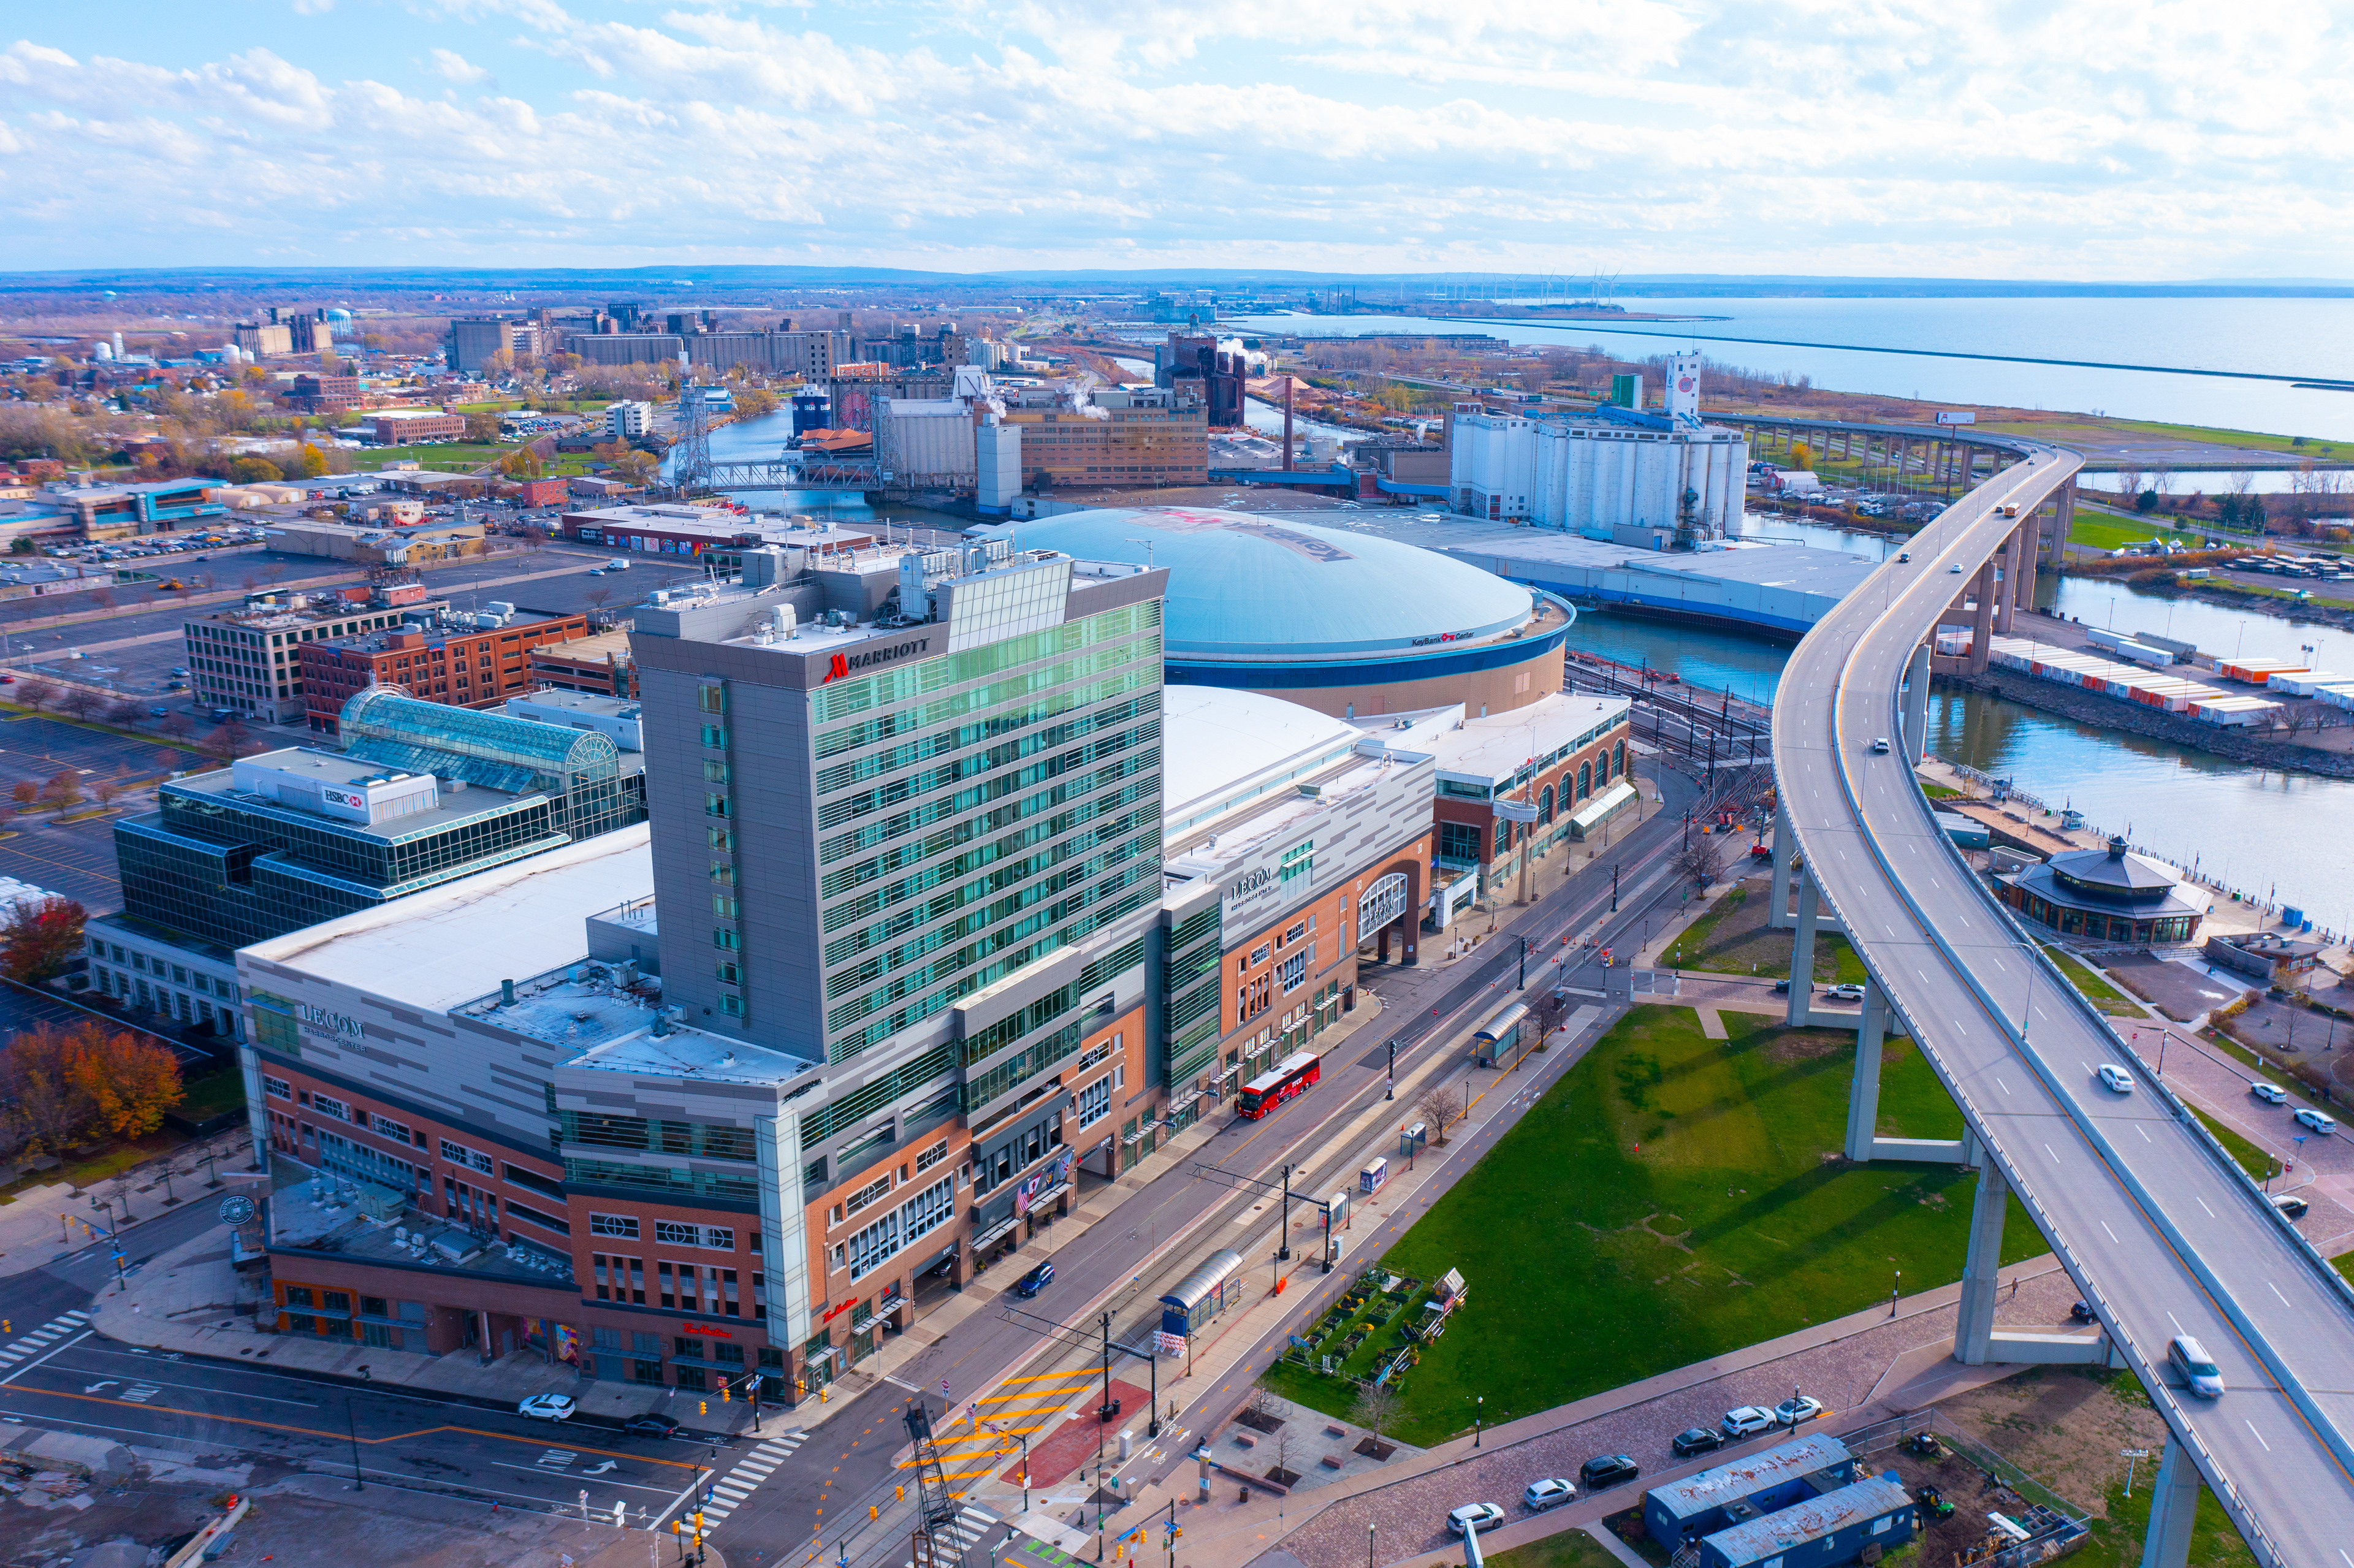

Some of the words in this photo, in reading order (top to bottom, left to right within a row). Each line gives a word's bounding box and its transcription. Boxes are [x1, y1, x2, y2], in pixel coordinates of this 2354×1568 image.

[1412, 636, 1441, 646] KeyBank
[849, 637, 931, 670] MARRIOTT
[324, 790, 349, 804] HSBC
[1232, 866, 1273, 900] LECOM
[302, 1004, 365, 1039] LECOM
[304, 1027, 367, 1052] HARBORCENTER
[783, 1078, 822, 1102] PANORAMA
[1100, 1136, 1111, 1147] ENTER
[222, 1198, 245, 1216] SOUTHERN
[943, 1245, 952, 1255] EXIT
[823, 1310, 834, 1323] Tim
[834, 1296, 858, 1315] Hortons
[683, 1323, 698, 1334] Tim
[699, 1325, 731, 1338] Hortons
[120, 1383, 162, 1402] ONLY
[535, 1449, 577, 1471] ONLY
